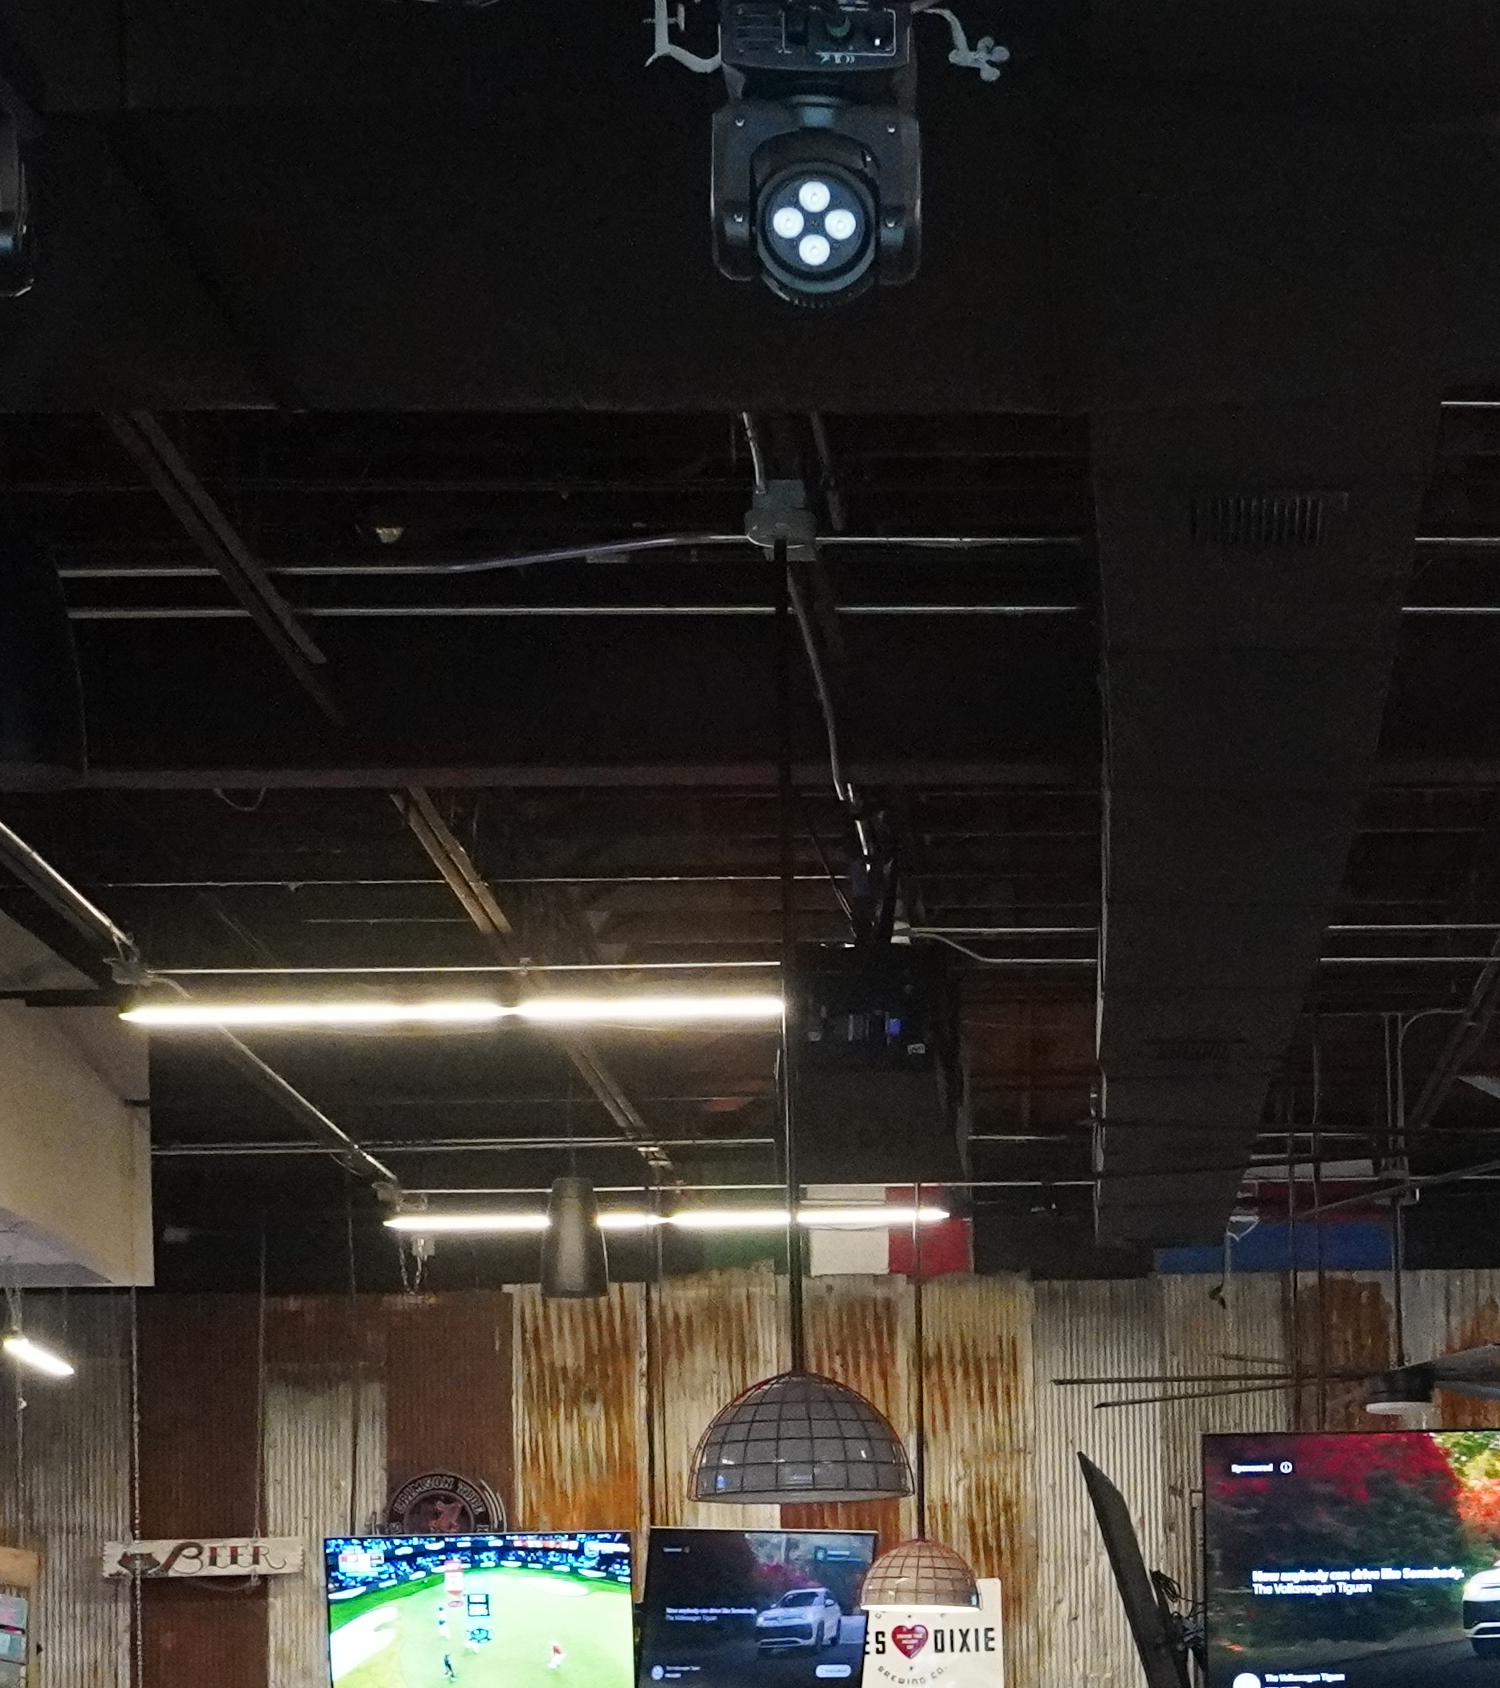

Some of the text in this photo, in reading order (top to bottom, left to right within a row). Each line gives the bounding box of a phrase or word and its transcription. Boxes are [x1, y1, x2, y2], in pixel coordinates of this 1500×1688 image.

[153, 1541, 286, 1575] BEER
[1252, 1570, 1280, 1582] Now
[1280, 1569, 1329, 1583] anybody
[1329, 1570, 1350, 1581] can
[1351, 1568, 1380, 1580] drive
[1381, 1567, 1401, 1580] like
[1252, 1582, 1373, 1596] The Volkswagen Tiguan
[933, 1627, 996, 1653] DIXIE
[876, 1665, 927, 1686] BREWING
